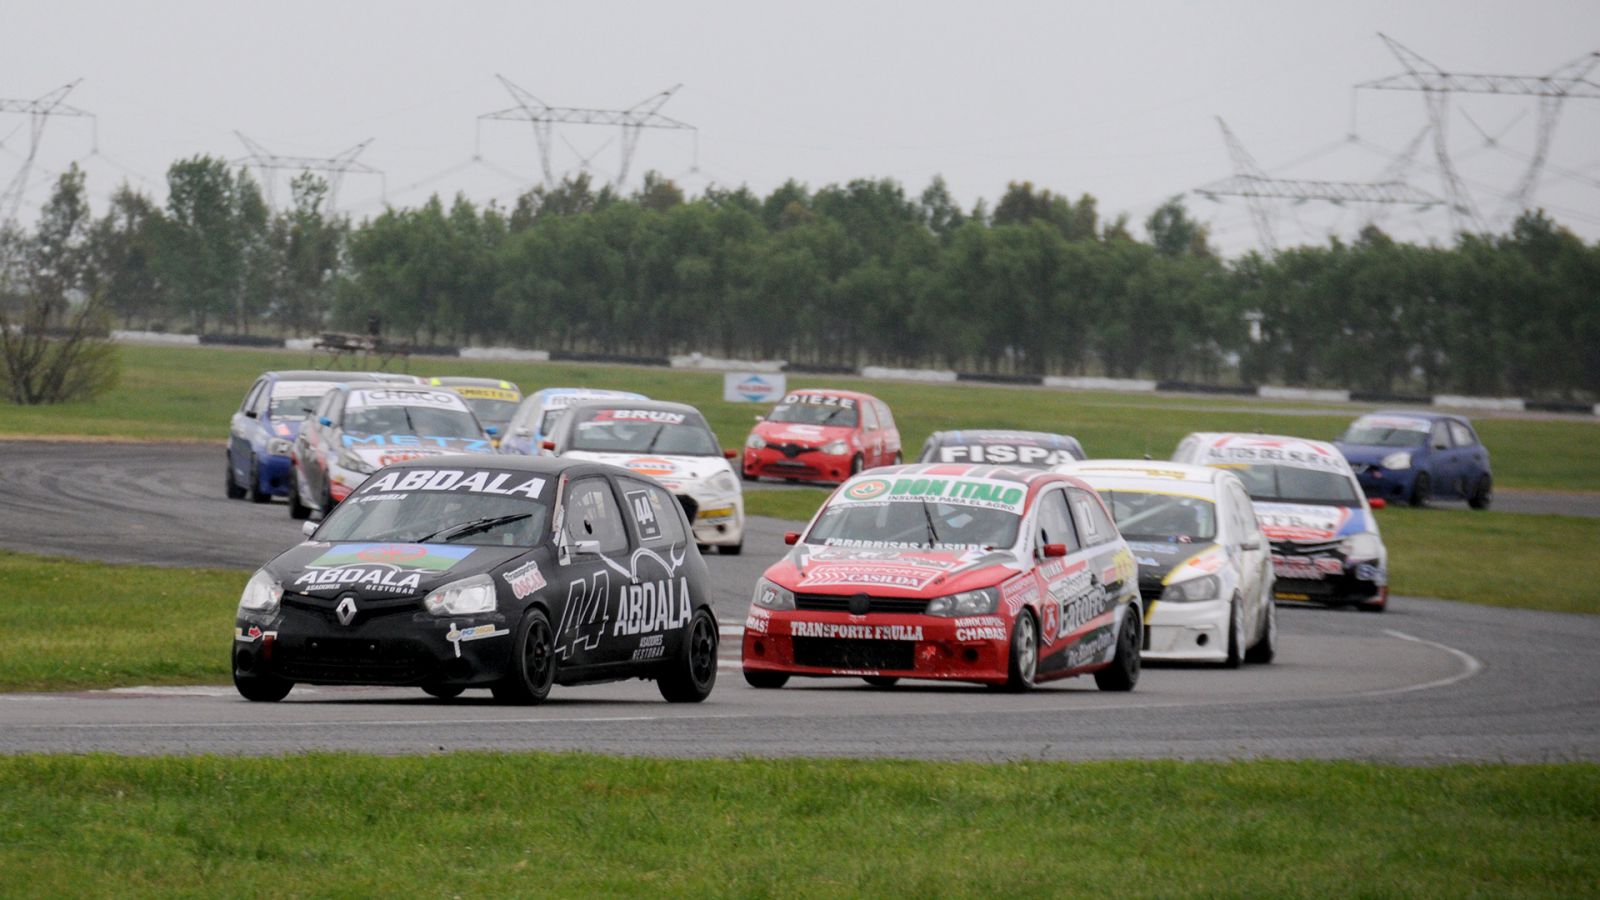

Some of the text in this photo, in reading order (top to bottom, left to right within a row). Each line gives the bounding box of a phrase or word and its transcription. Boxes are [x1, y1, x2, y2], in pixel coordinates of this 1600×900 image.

[369, 389, 453, 404] CHACO
[784, 395, 855, 409] DIEZE
[342, 432, 492, 453] METZ
[940, 445, 1077, 465] FISPA
[360, 470, 547, 499] ABDALA
[890, 478, 1023, 505] DON ITALO
[634, 496, 654, 525] 44
[985, 502, 1015, 511] AGRO
[824, 538, 920, 551] PARABRISAS
[294, 568, 421, 589] ABDALA
[818, 565, 931, 577] TRANSPORTE
[848, 574, 920, 587] CASILDA
[365, 585, 415, 595] RESTOBAR
[761, 591, 776, 604] 10
[554, 570, 609, 660] 44
[613, 577, 692, 637] ABDALA
[790, 621, 924, 641] TRANSPORTE FRULLA
[632, 646, 665, 660] RESTOBAR
